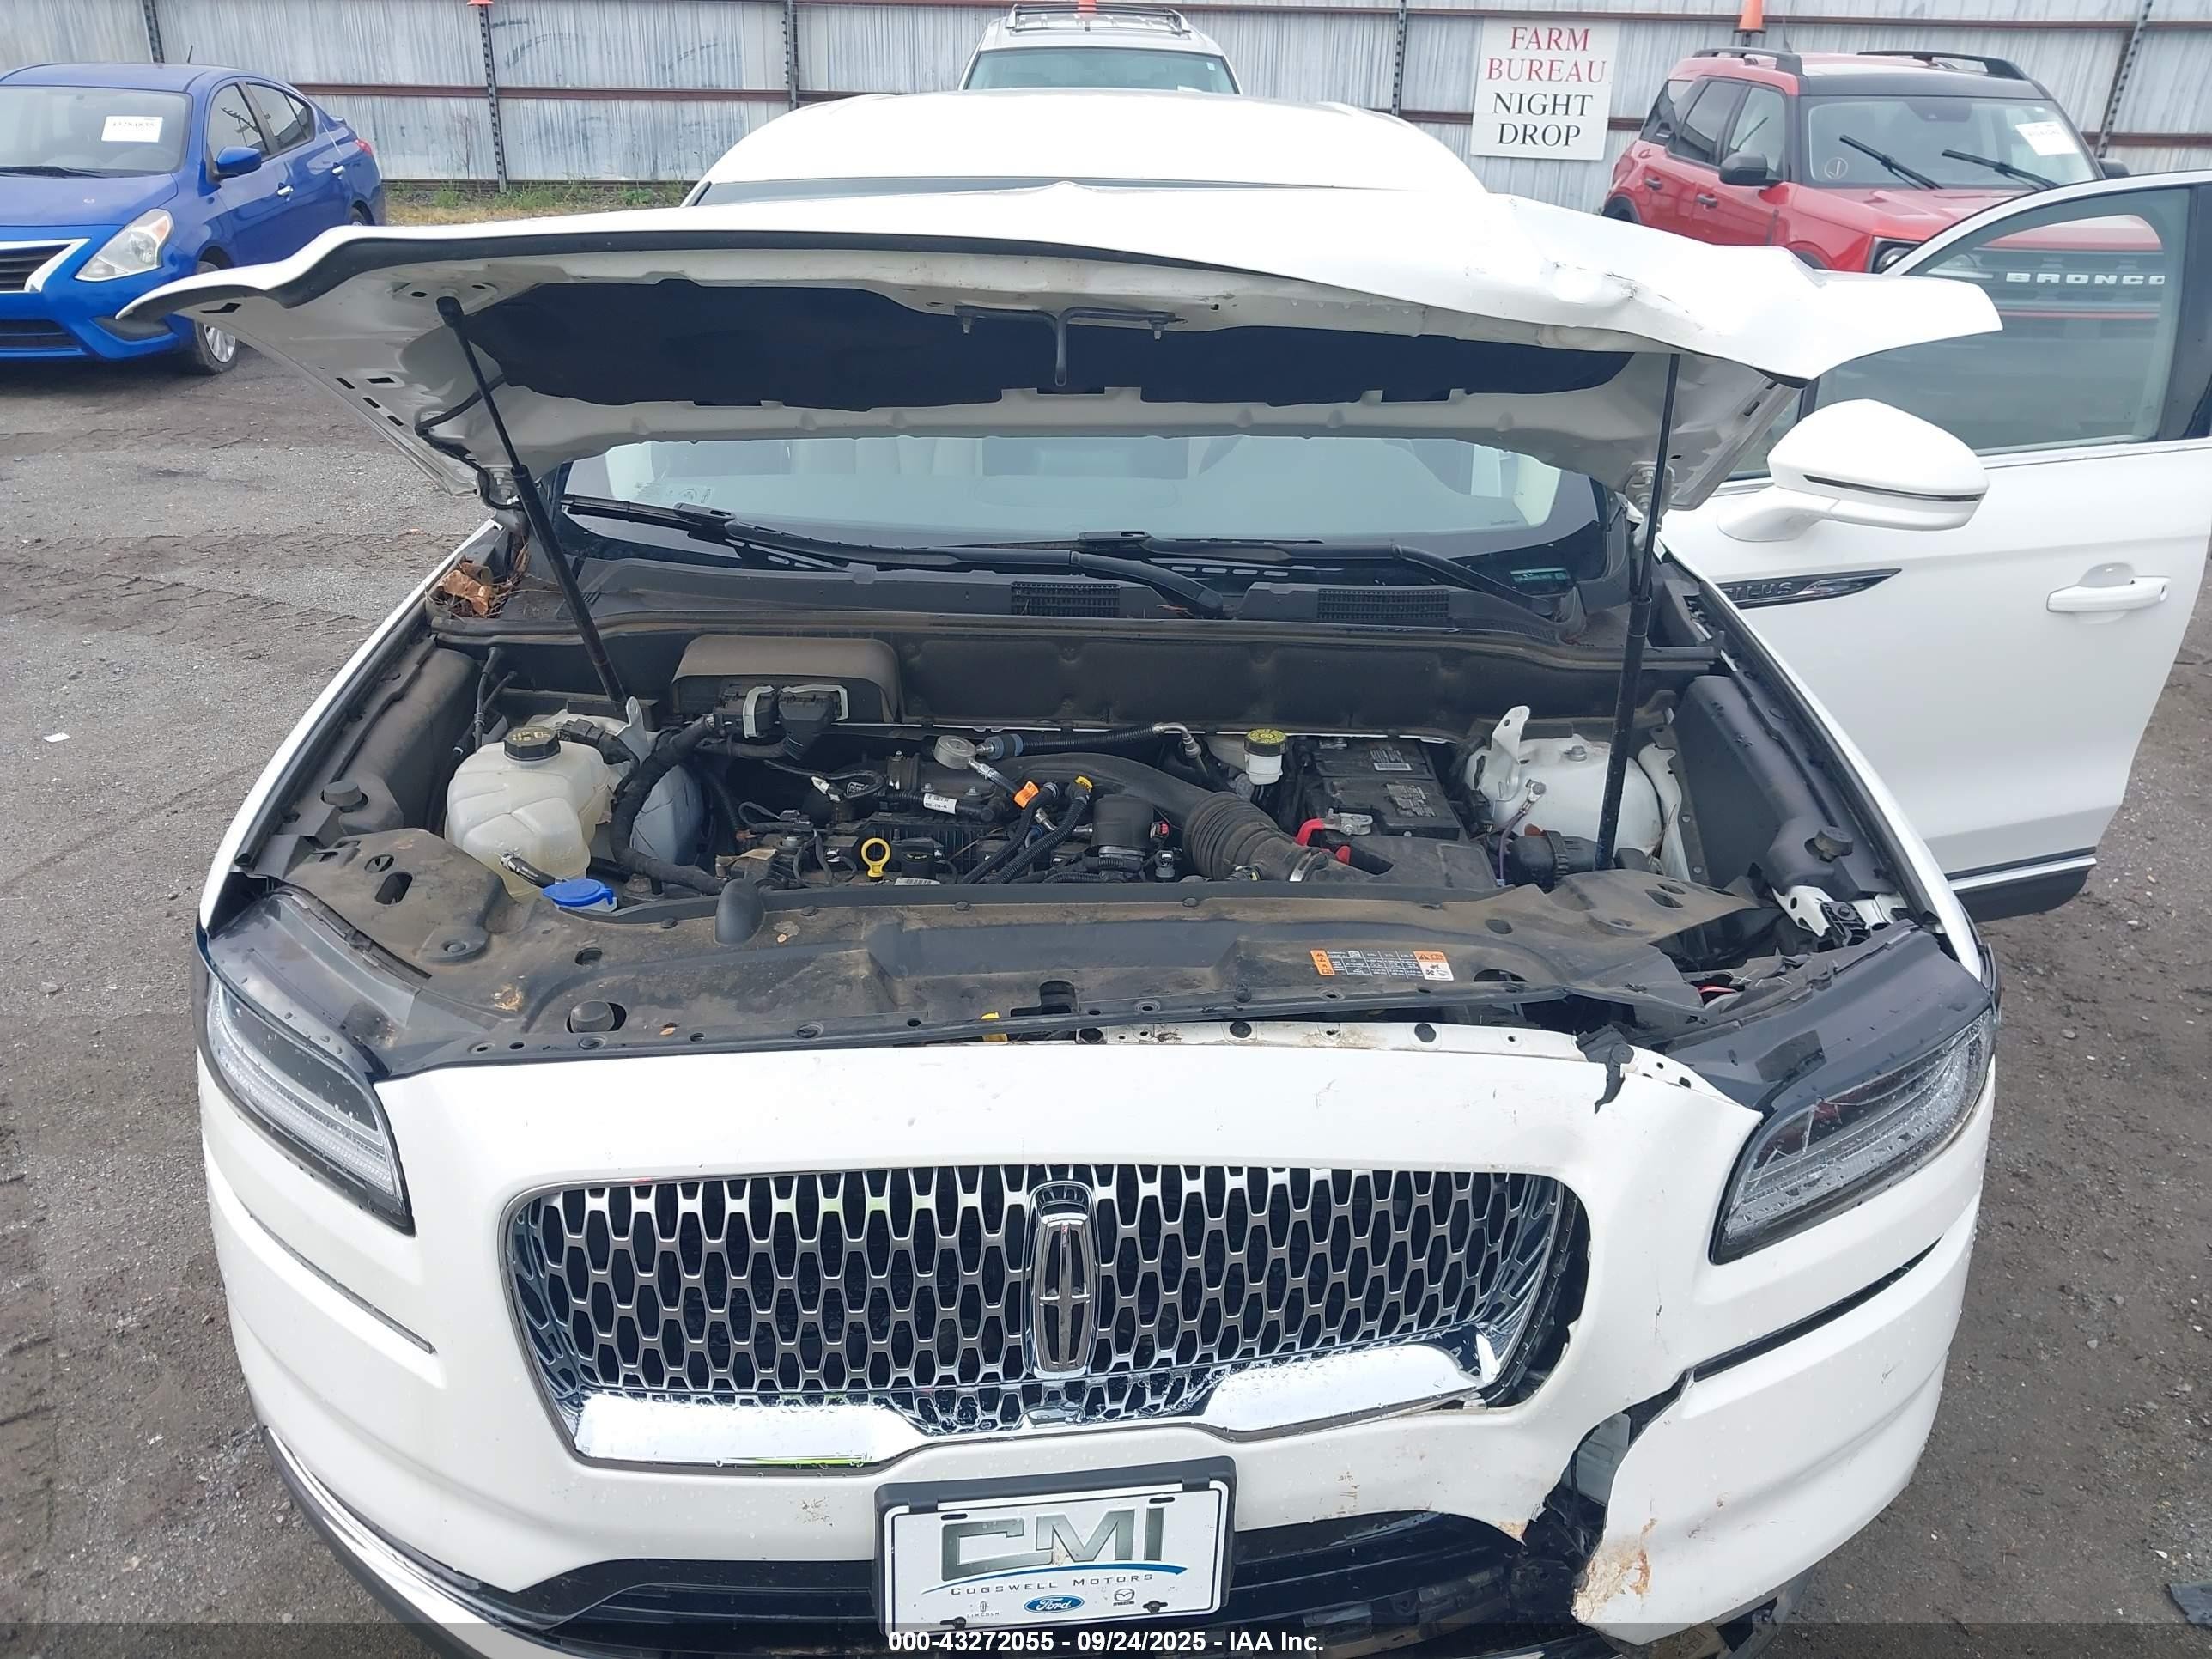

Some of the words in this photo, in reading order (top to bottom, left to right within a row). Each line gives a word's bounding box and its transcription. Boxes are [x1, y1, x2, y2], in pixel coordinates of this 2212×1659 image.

[1510, 27, 1591, 52] FARM
[1486, 58, 1607, 83] BUREAU
[1492, 92, 1594, 117] NIGHT
[1497, 123, 1581, 147] DROP
[2006, 272, 2166, 285] BRONCO
[941, 1506, 1164, 1583] CMI
[951, 1582, 1058, 1595] COGSWELL
[1073, 1573, 1153, 1587] MOTORS
